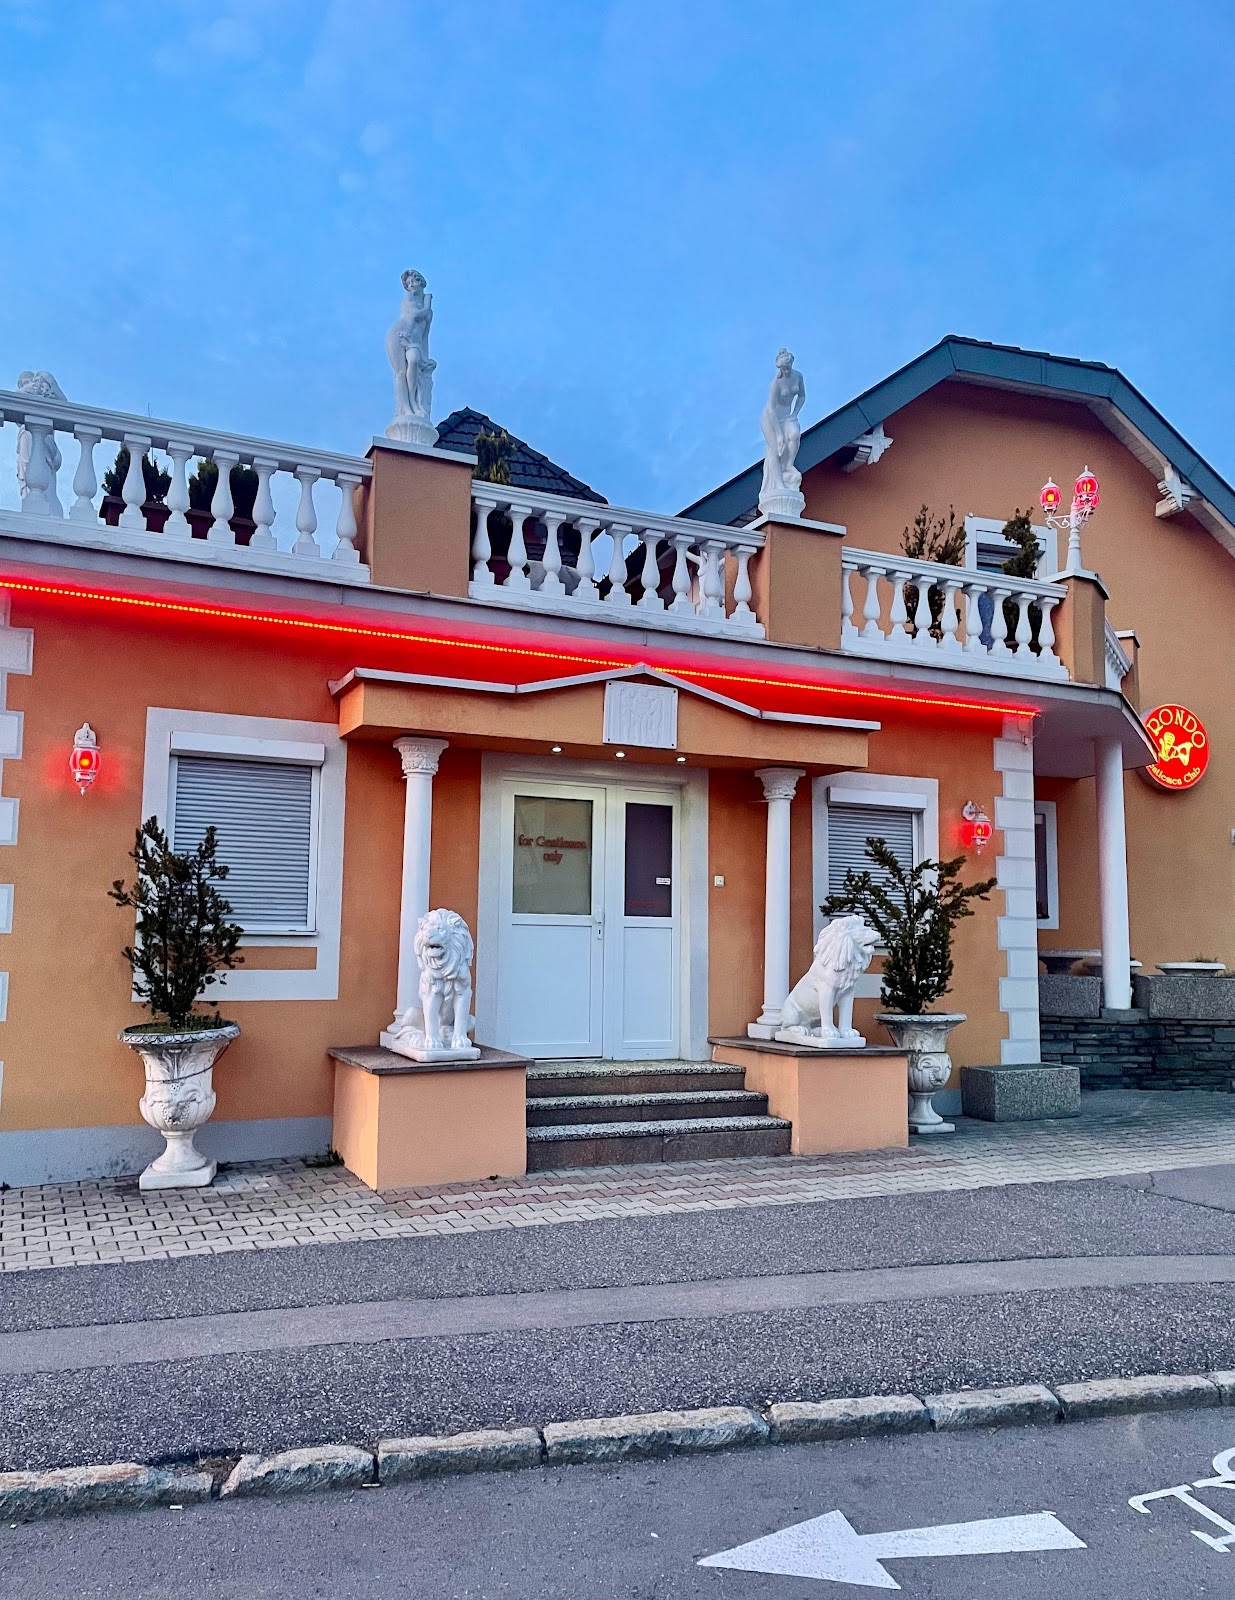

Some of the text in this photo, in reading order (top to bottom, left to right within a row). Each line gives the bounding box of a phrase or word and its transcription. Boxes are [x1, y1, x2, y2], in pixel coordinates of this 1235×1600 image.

[1146, 709, 1206, 748] RONDO
[1149, 764, 1201, 785] entlemen Club
[519, 834, 534, 846] for
